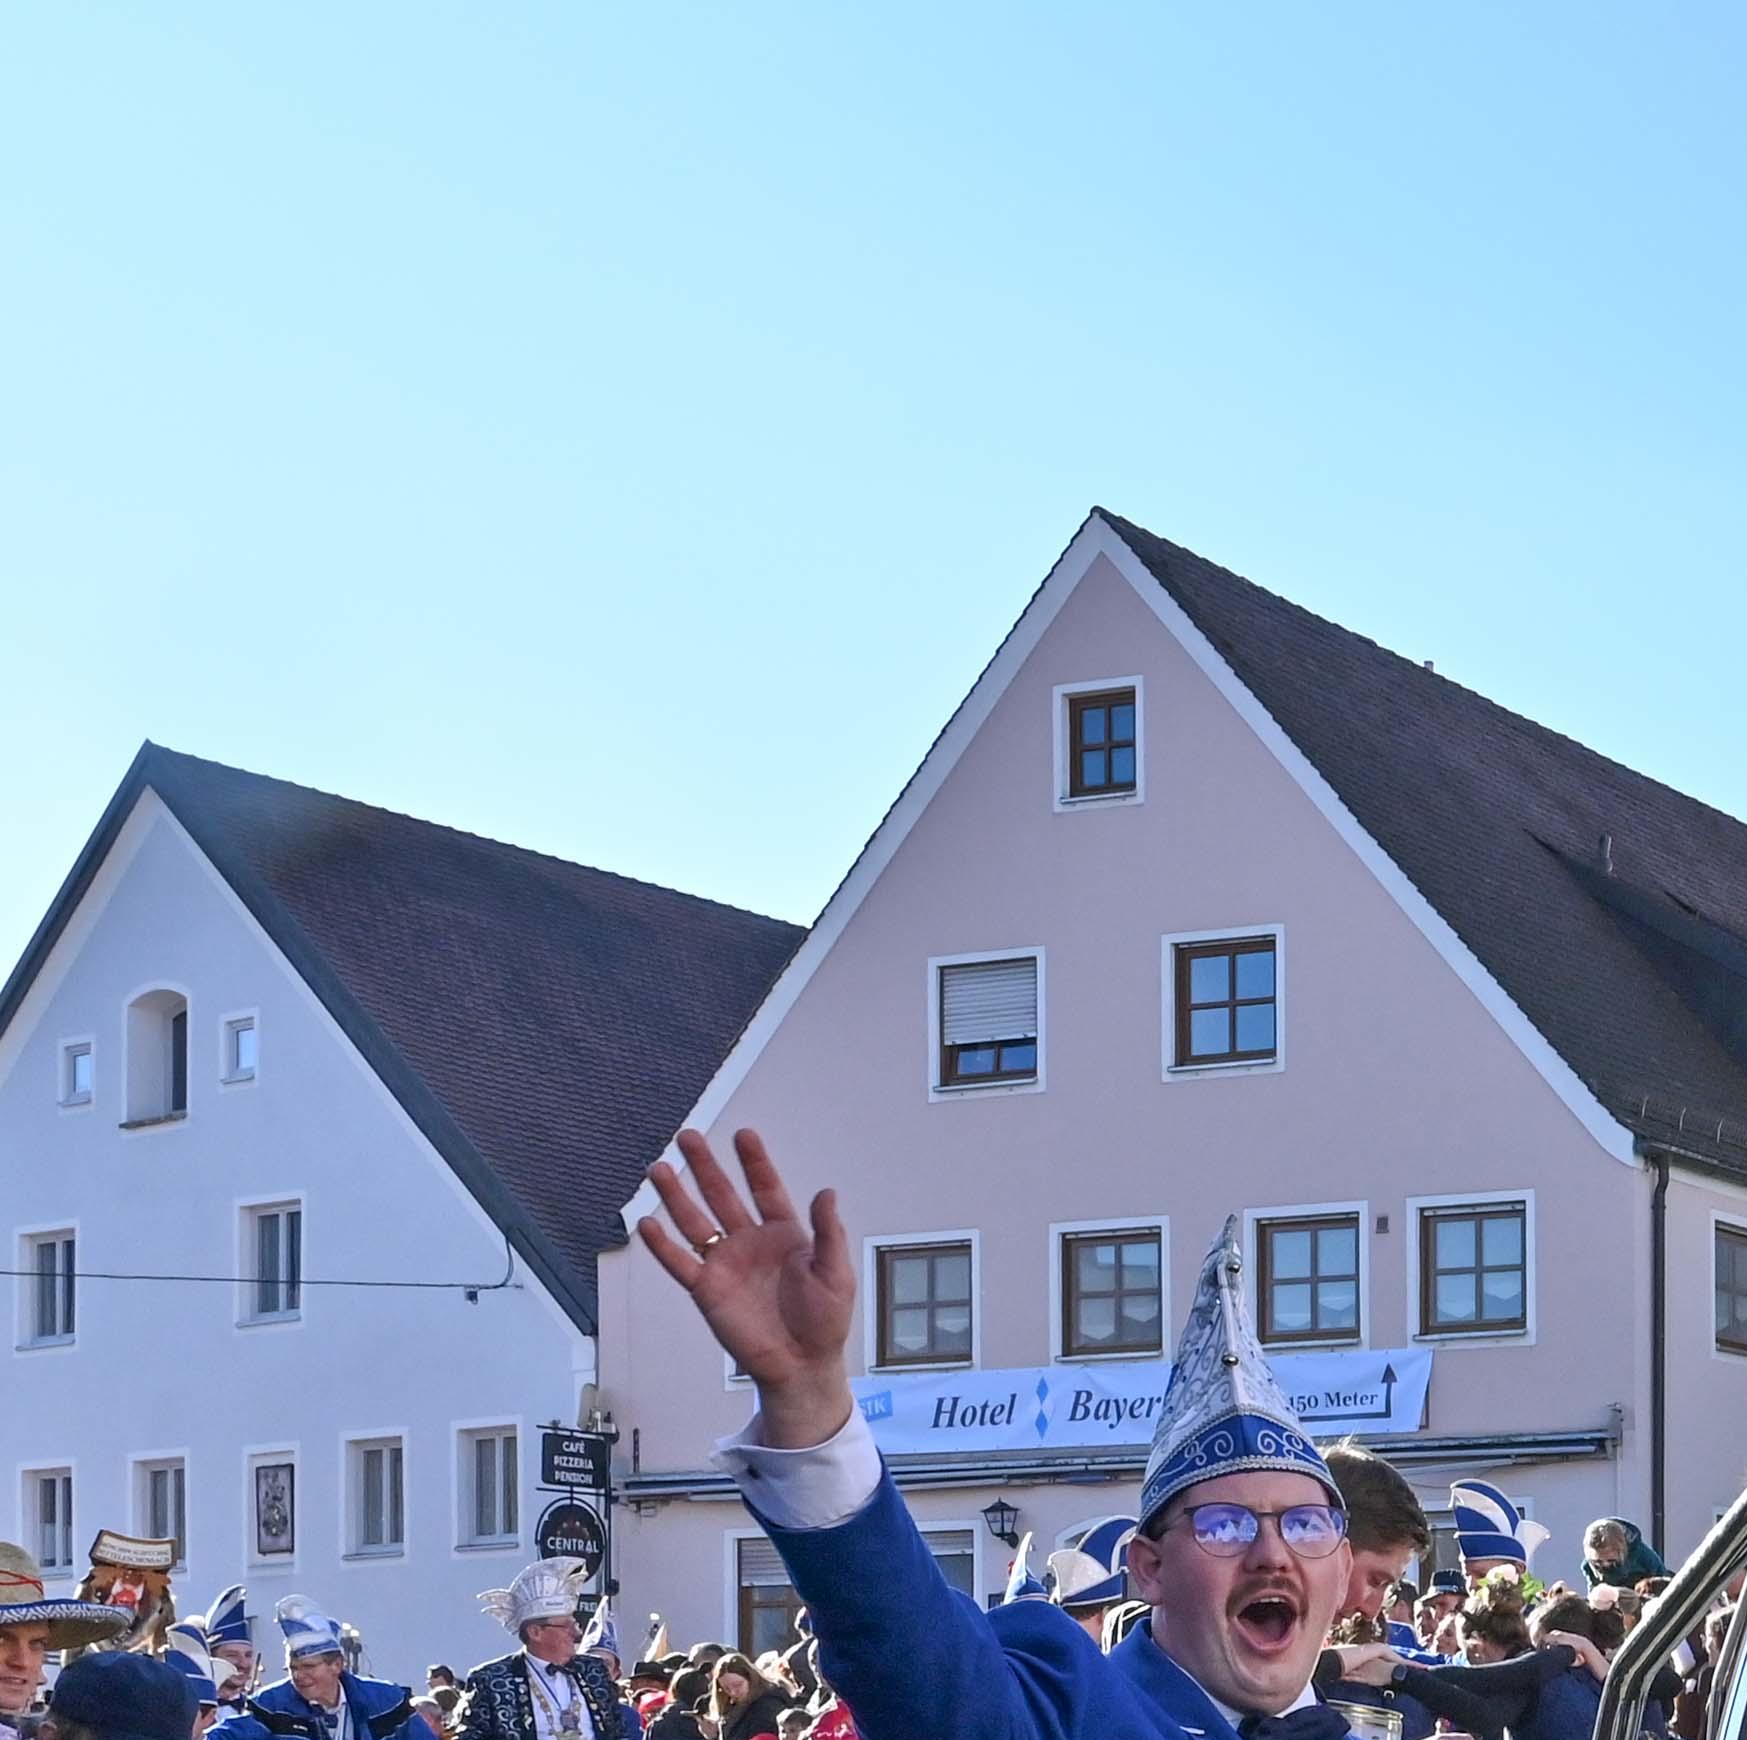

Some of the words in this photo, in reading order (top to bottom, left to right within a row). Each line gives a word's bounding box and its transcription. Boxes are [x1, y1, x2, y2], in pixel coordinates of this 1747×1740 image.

[930, 1392, 1017, 1429] Hotel
[1068, 1387, 1162, 1431] Bayer
[1288, 1394, 1319, 1413] 150
[1323, 1391, 1379, 1409] Meter
[553, 1455, 594, 1470] PIZZERIA
[554, 1471, 593, 1486] PENSION
[546, 1536, 600, 1554] CENTRAL
